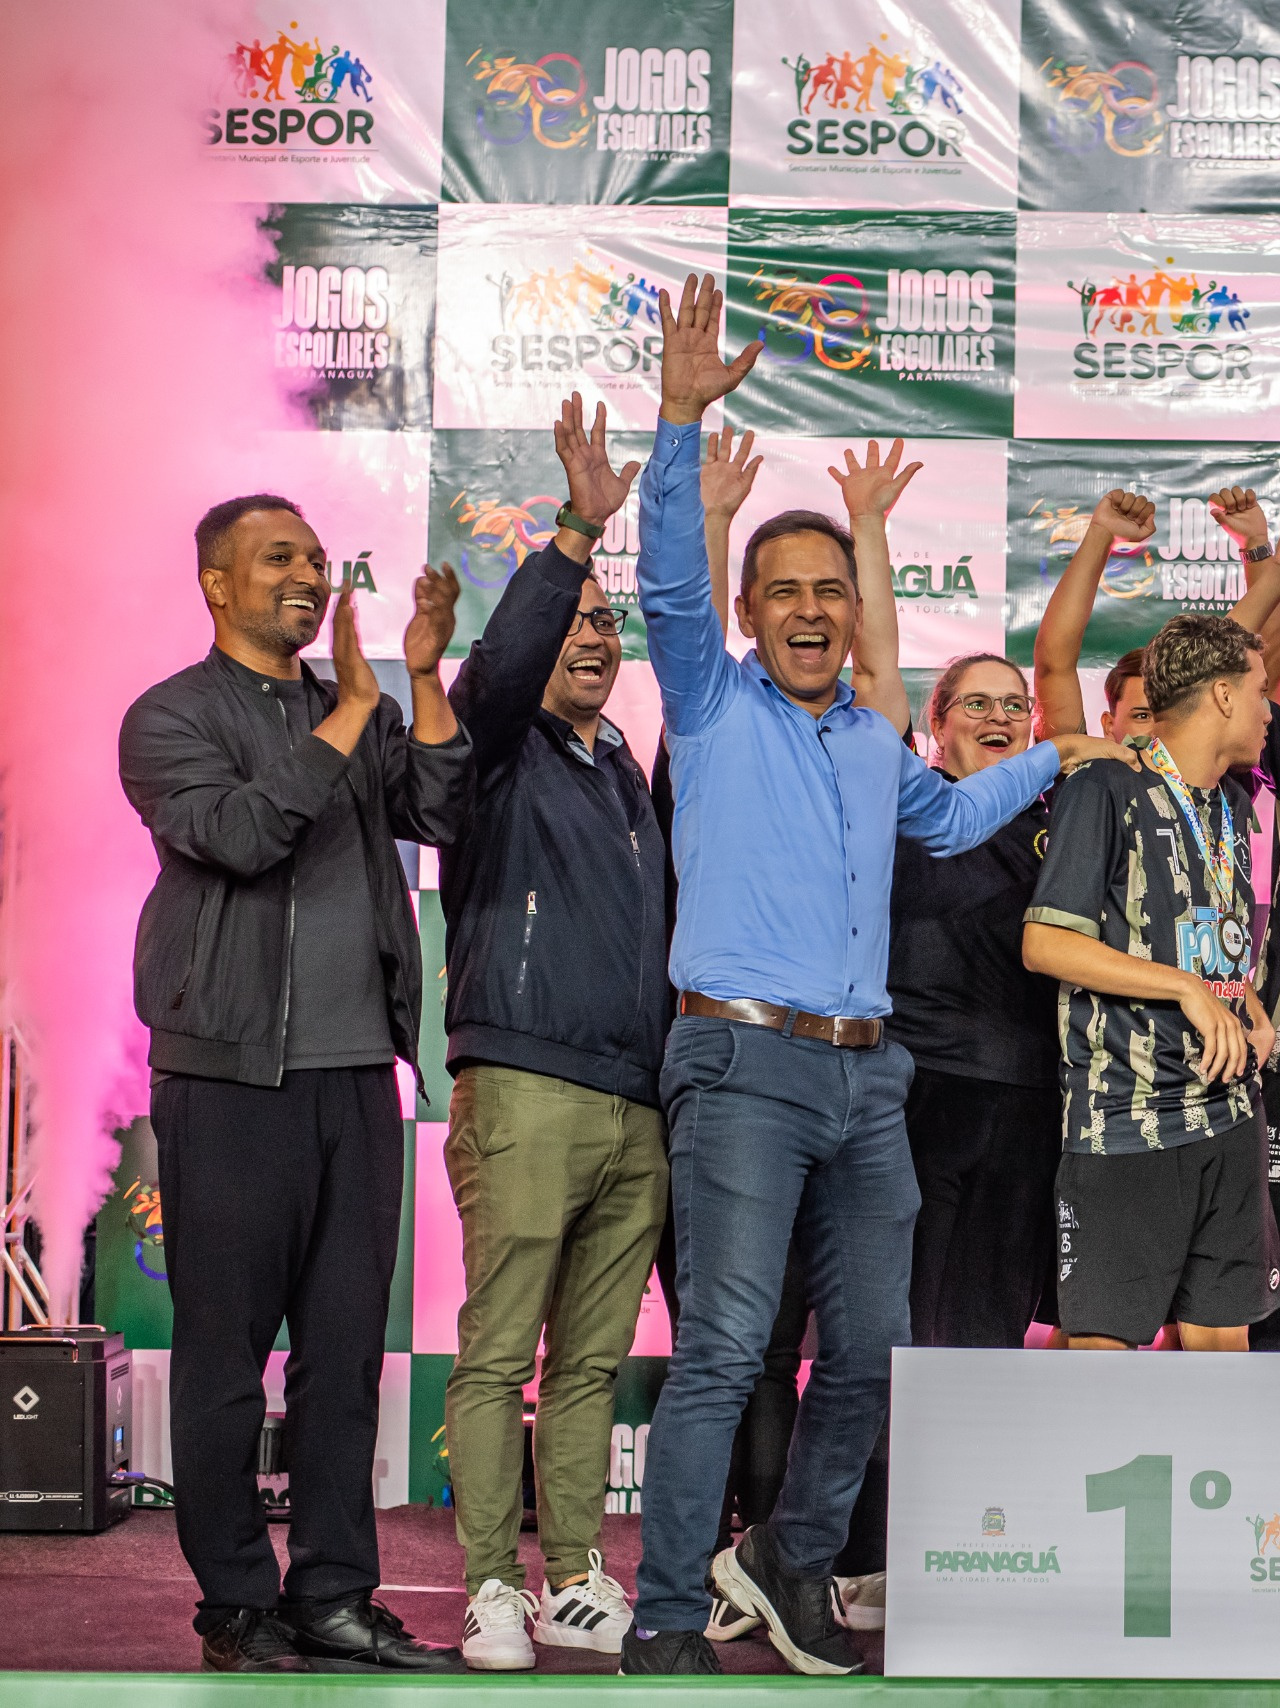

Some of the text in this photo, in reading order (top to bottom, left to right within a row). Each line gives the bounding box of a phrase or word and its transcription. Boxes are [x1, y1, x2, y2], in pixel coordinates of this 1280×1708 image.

[593, 47, 711, 113] JOGOS
[201, 108, 374, 146] SESPOR
[597, 113, 711, 153] ESCOLARES
[787, 119, 965, 157] SESPOR
[238, 155, 276, 164] Municipal
[279, 155, 288, 163] de
[290, 155, 320, 164] Esporte
[330, 155, 371, 164] Juventude
[870, 166, 880, 174] de
[271, 265, 389, 330] JOGOS
[876, 268, 994, 332] JOGOS
[274, 331, 390, 369] ESCOLARES
[879, 333, 995, 371] ESCOLARES
[1073, 342, 1252, 381] SESPOR
[1182, 602, 1234, 611] PARANA
[1156, 829, 1182, 876] 7
[925, 1546, 1061, 1573] PARANAGUÁ
